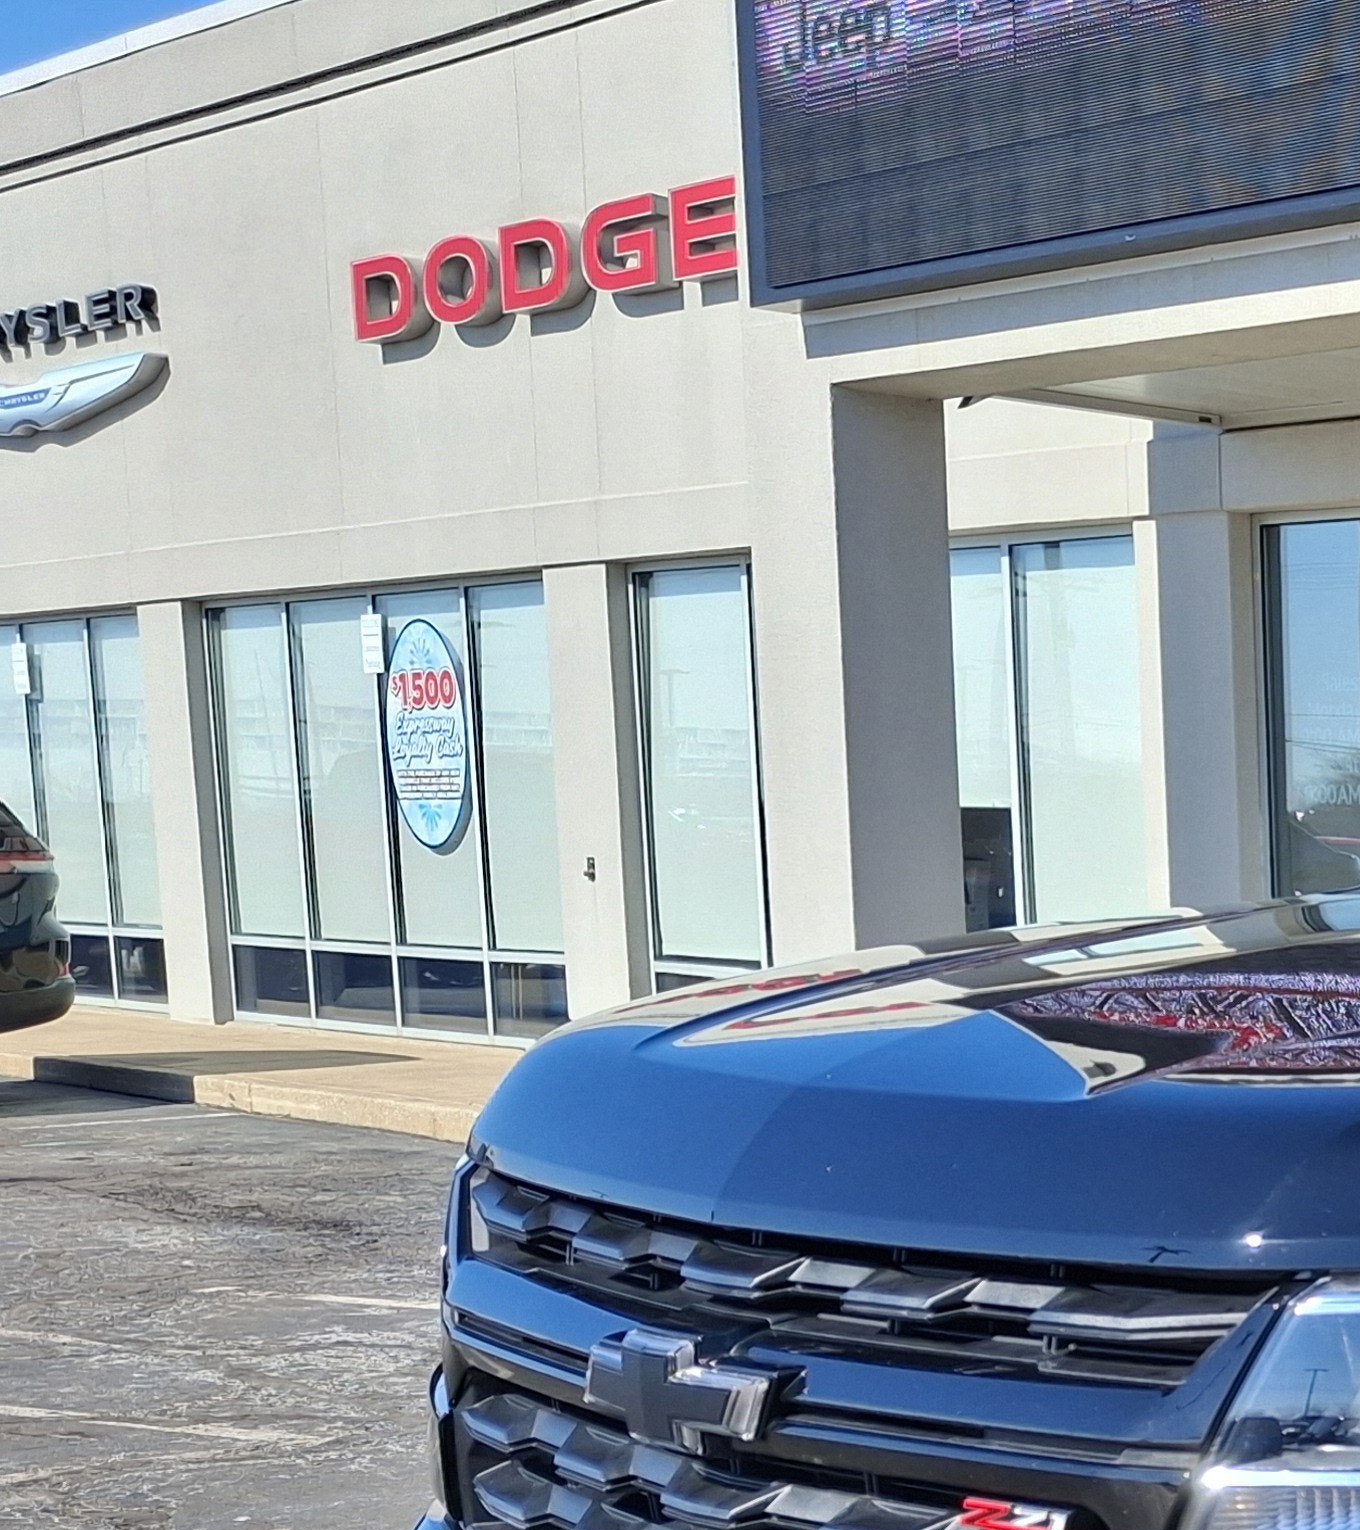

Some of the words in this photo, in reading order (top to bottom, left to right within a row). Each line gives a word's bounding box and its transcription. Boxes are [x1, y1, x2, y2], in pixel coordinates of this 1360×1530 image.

[780, 2, 893, 74] Jeep
[351, 175, 738, 341] DODGE
[390, 667, 456, 713] $1,500
[436, 733, 463, 759] Cash
